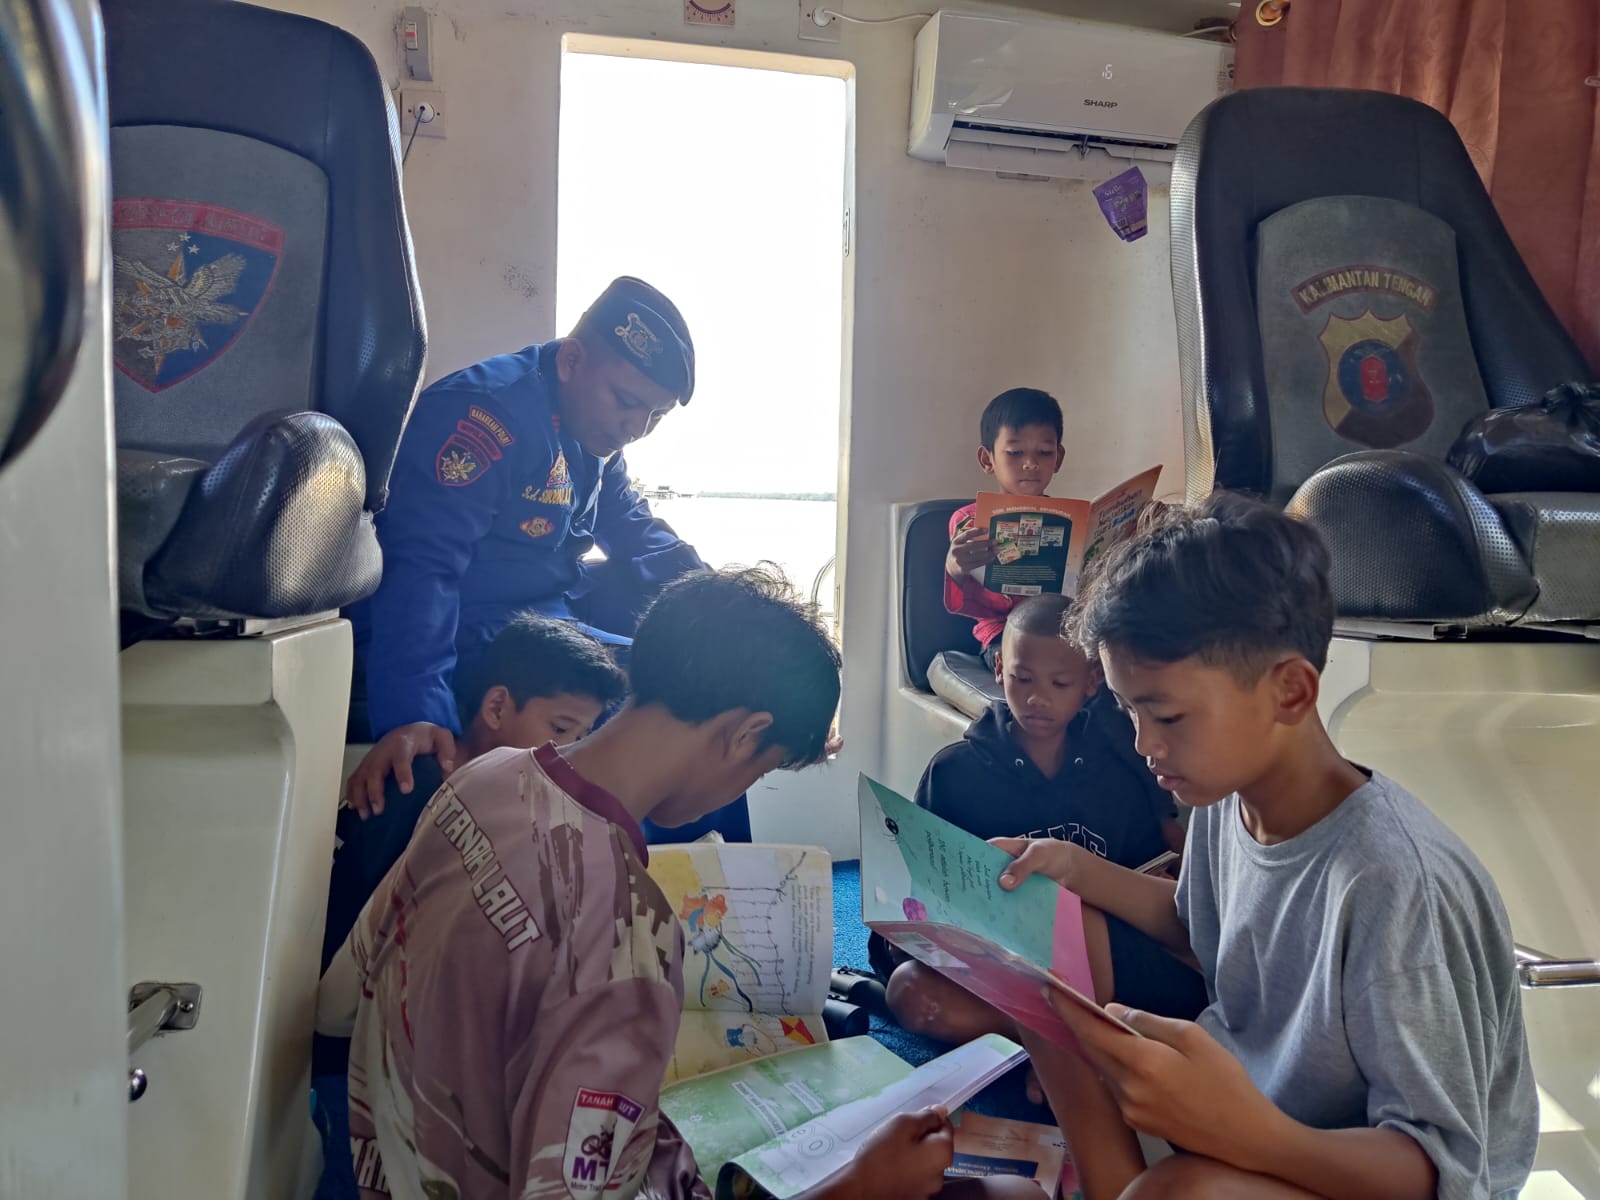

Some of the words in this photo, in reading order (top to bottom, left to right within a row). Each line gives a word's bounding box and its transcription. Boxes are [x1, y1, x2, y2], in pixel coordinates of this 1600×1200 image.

[1083, 98, 1118, 109] SHARP
[1299, 270, 1379, 305] KALIMANTAN
[434, 793, 496, 880] TANAH
[472, 860, 543, 952] LAUT
[581, 1094, 614, 1105] TANAH
